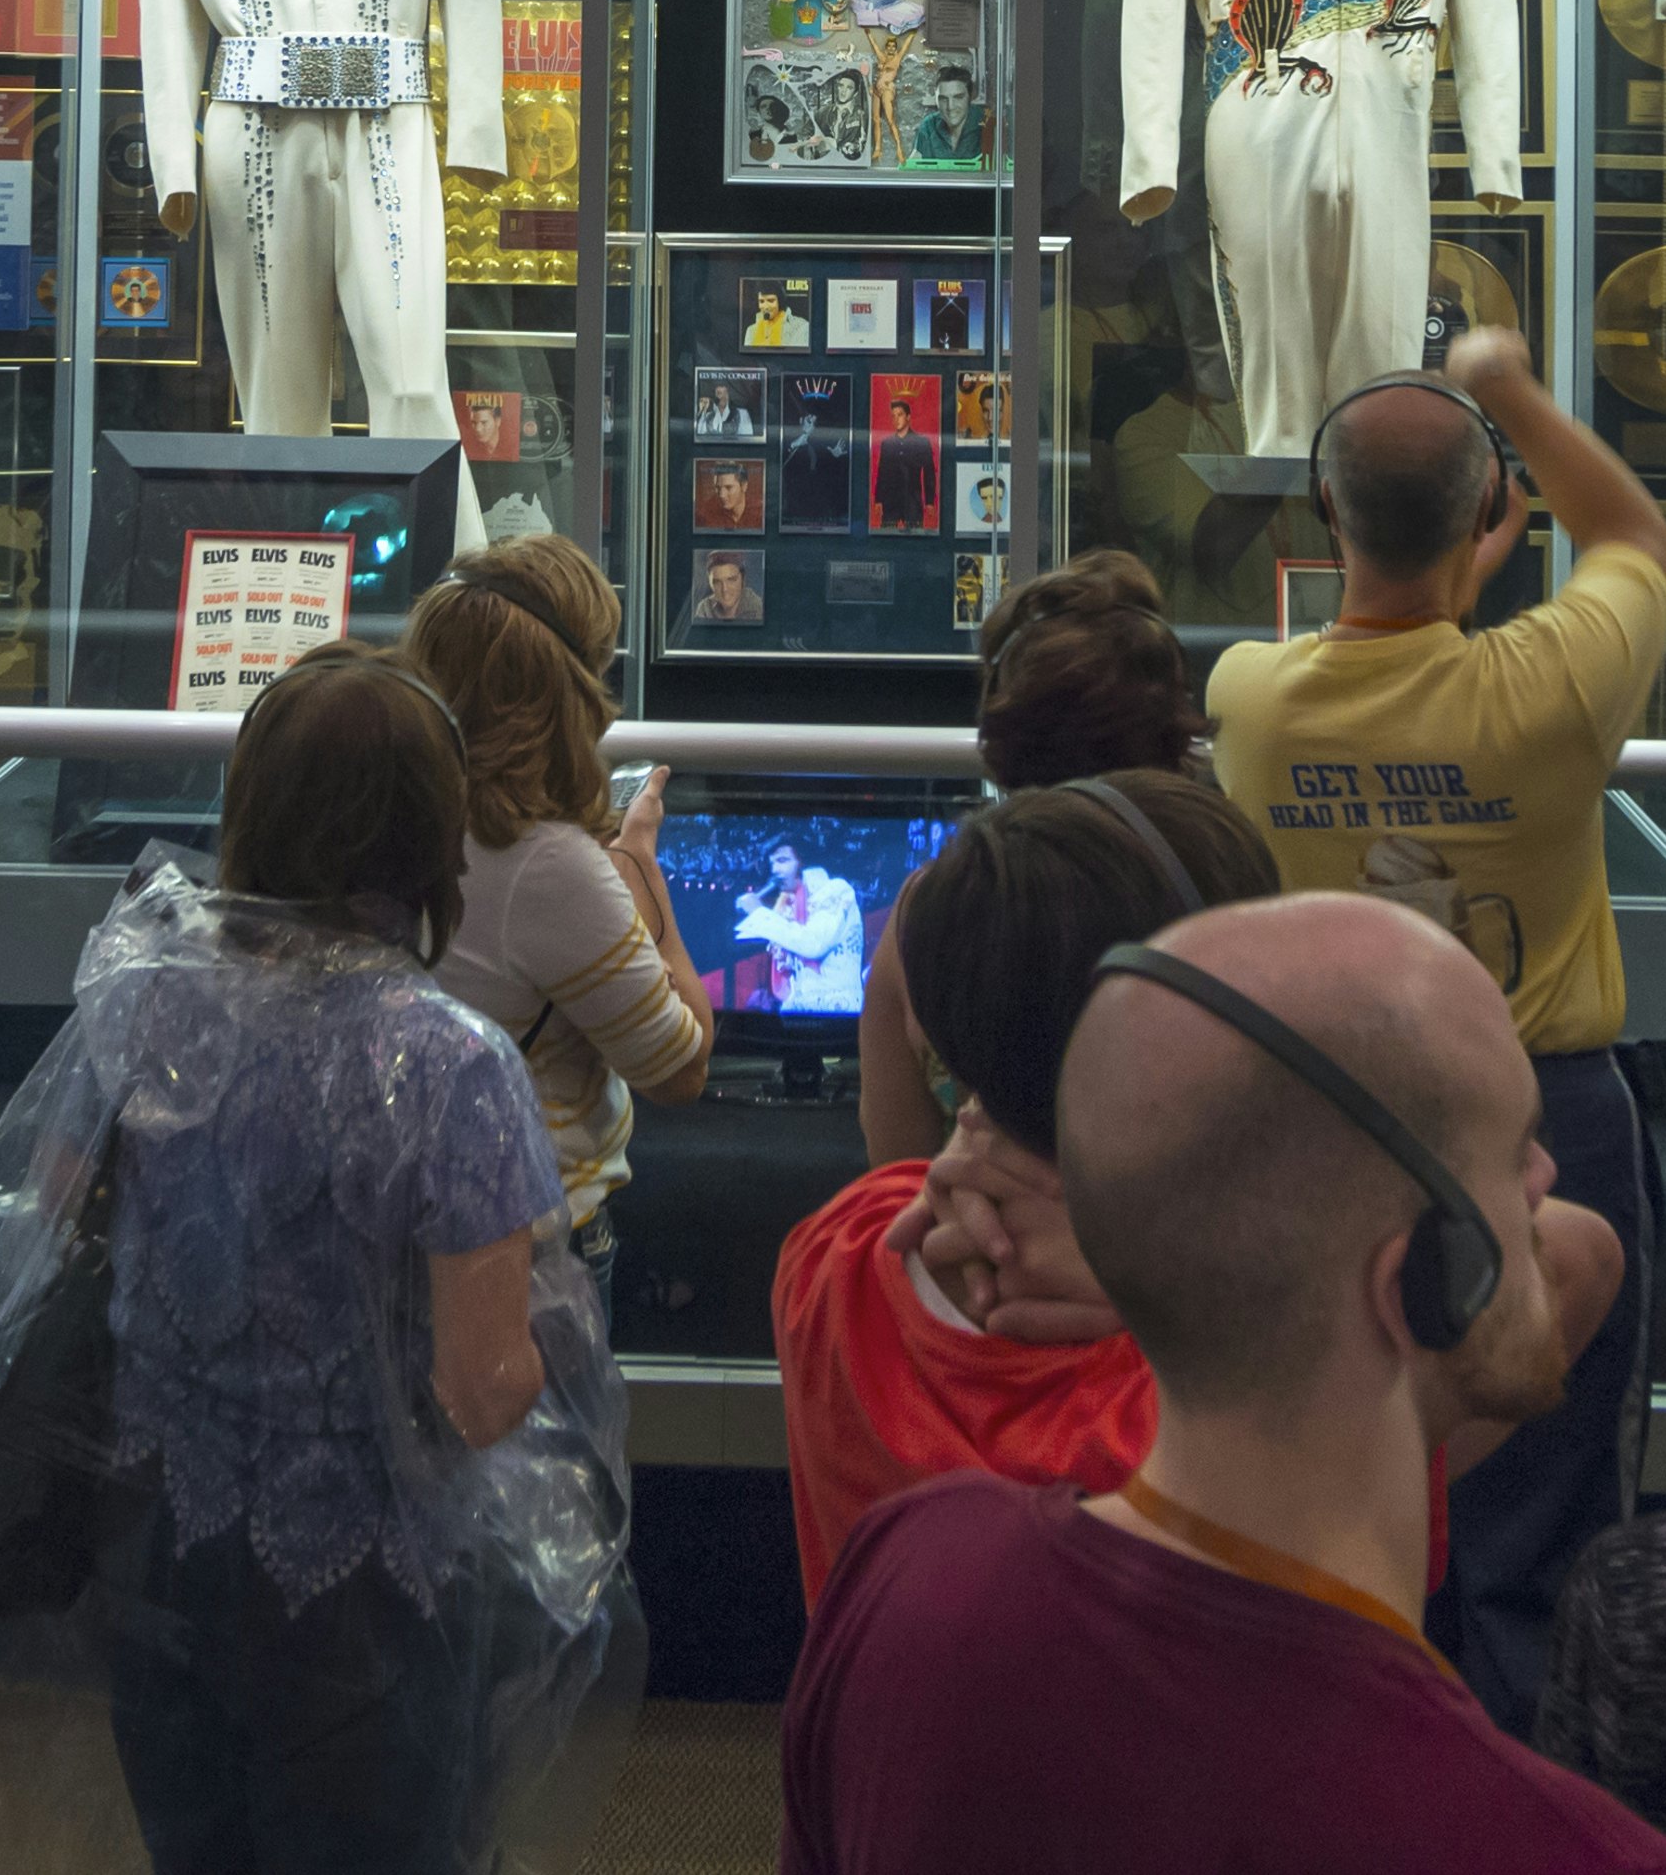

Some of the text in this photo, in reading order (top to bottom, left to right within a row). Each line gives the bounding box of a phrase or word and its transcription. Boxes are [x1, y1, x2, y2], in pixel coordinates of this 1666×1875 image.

[203, 548, 335, 568] ELVIS ELVIS ELVIS
[203, 592, 239, 604] SOLD OUT
[247, 592, 283, 602] SOLD OUT
[289, 593, 326, 608] SOLD OUT
[196, 609, 330, 629] ELVIS ELVIS ELVIS
[196, 644, 216, 656] SOLD
[241, 654, 277, 665] SOLD OUT
[189, 670, 275, 687] ELVIS ELVIS
[1291, 764, 1470, 798] GET YOUR
[1269, 797, 1518, 829] HEAD IN THE GAME
